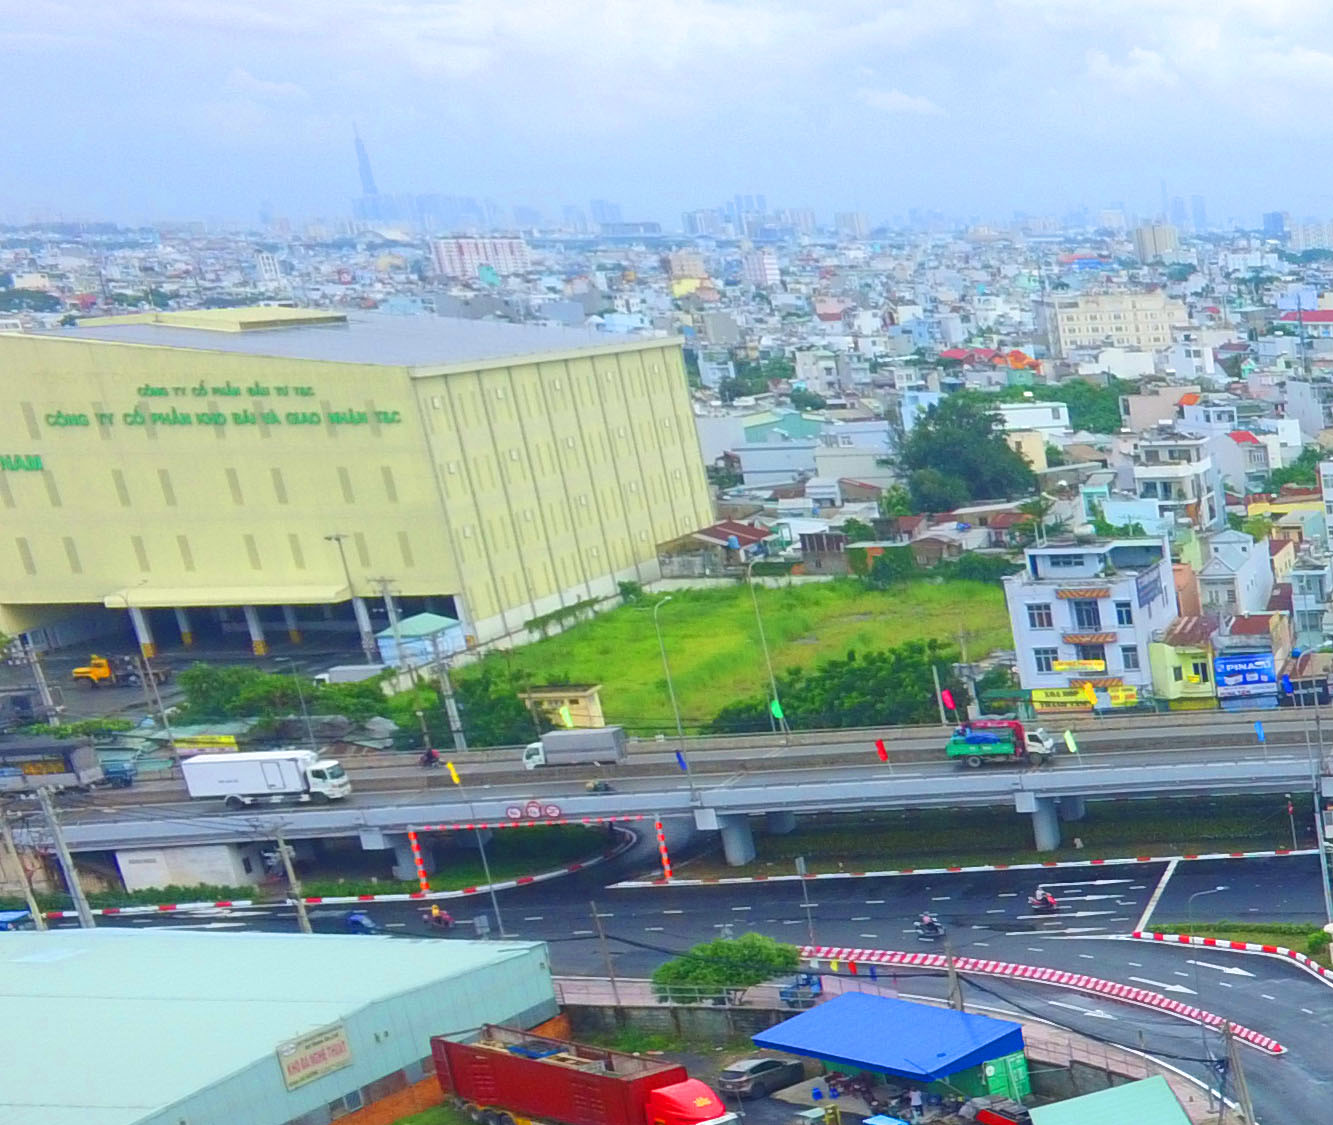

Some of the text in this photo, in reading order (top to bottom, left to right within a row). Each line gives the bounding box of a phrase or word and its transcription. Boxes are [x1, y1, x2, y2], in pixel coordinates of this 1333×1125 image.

[138, 384, 168, 397] CÔNG
[172, 387, 186, 397] TY
[191, 381, 208, 397] CỔ
[211, 382, 241, 397] PHẦN
[45, 408, 90, 427] CÔNG
[95, 412, 114, 426] TY
[122, 405, 145, 426] CỔ
[151, 405, 192, 426] PHẦN
[285, 411, 320, 426] GIAO
[328, 408, 368, 427] NHẬN
